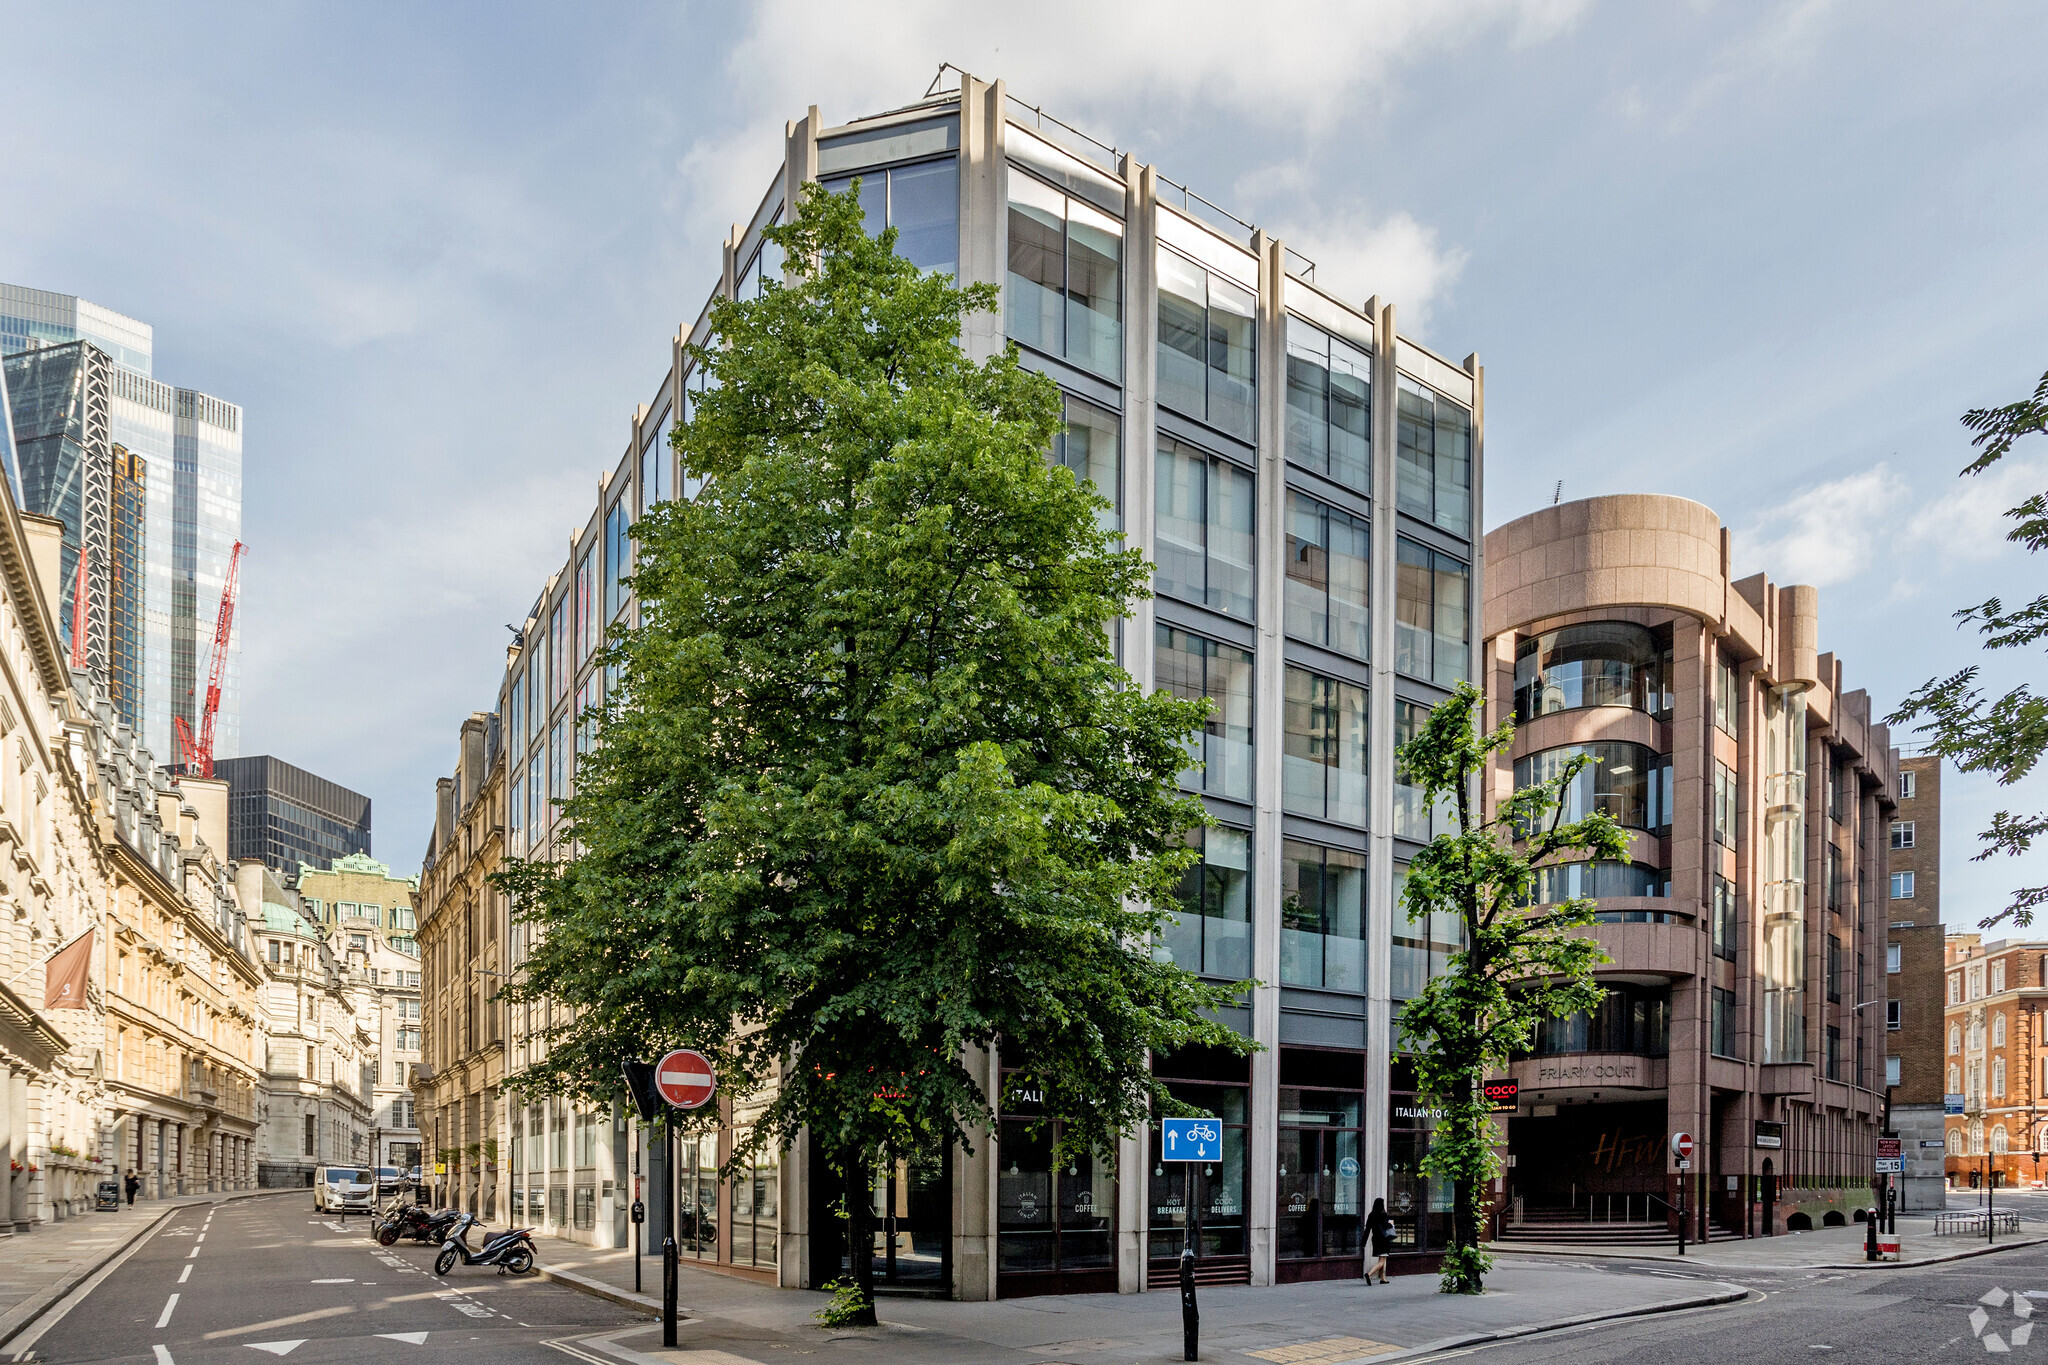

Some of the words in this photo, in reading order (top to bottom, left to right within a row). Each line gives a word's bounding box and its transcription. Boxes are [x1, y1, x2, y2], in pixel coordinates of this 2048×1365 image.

[1539, 1066, 1590, 1081] FRIARY
[1593, 1065, 1637, 1078] COURT
[1485, 1085, 1518, 1096] COCO
[1011, 1089, 1043, 1102] ITALI
[1395, 1107, 1429, 1118] ITALIAN
[1431, 1109, 1442, 1118] TO
[1590, 1127, 1668, 1173] HFW
[1890, 1161, 1900, 1170] 15
[1018, 1191, 1039, 1201] ITALIAN
[1166, 1198, 1181, 1206] HOT
[1074, 1204, 1098, 1213] COFFEE
[1157, 1206, 1187, 1215] BREAKFAS
[1210, 1206, 1238, 1214] DELIVERS
[1288, 1204, 1307, 1212] COFFEE
